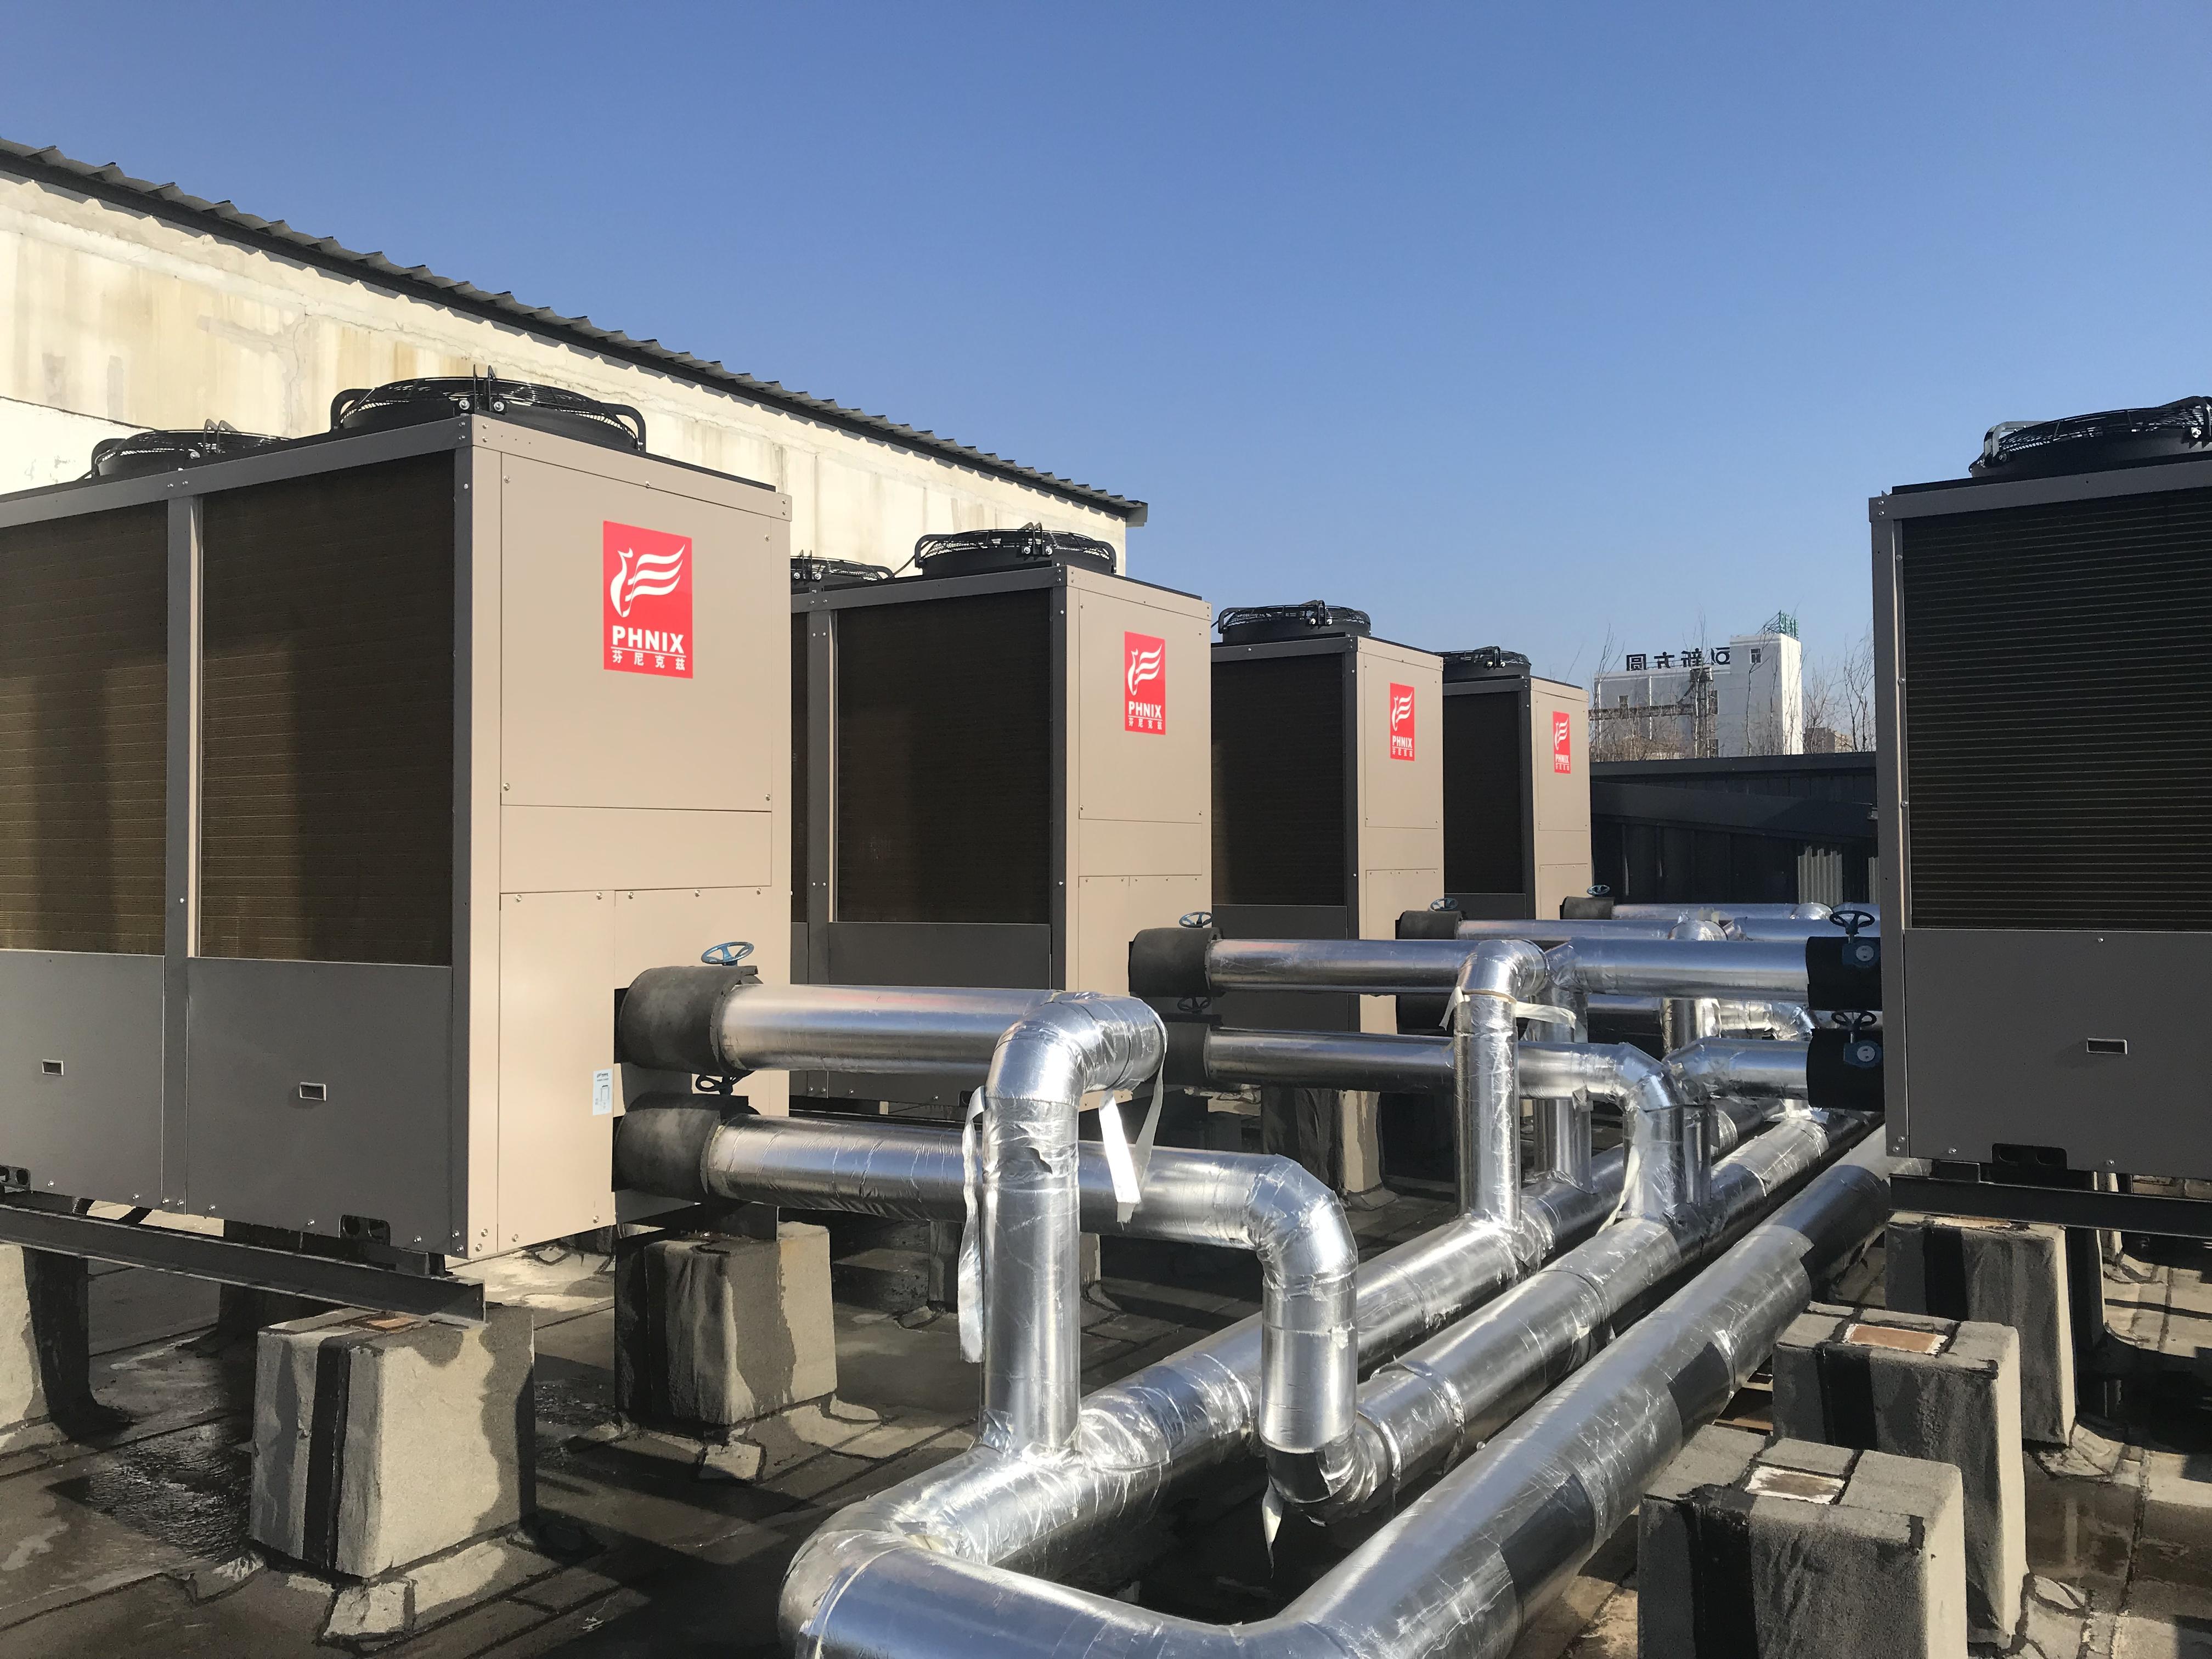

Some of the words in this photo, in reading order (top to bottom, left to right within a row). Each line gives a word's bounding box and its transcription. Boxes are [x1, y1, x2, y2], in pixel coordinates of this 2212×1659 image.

[612, 625, 684, 654] PHNIX
[612, 650, 686, 671] 芬尼克兹
[1128, 701, 1162, 719] PHNIX
[1392, 735, 1413, 748] PHNIX
